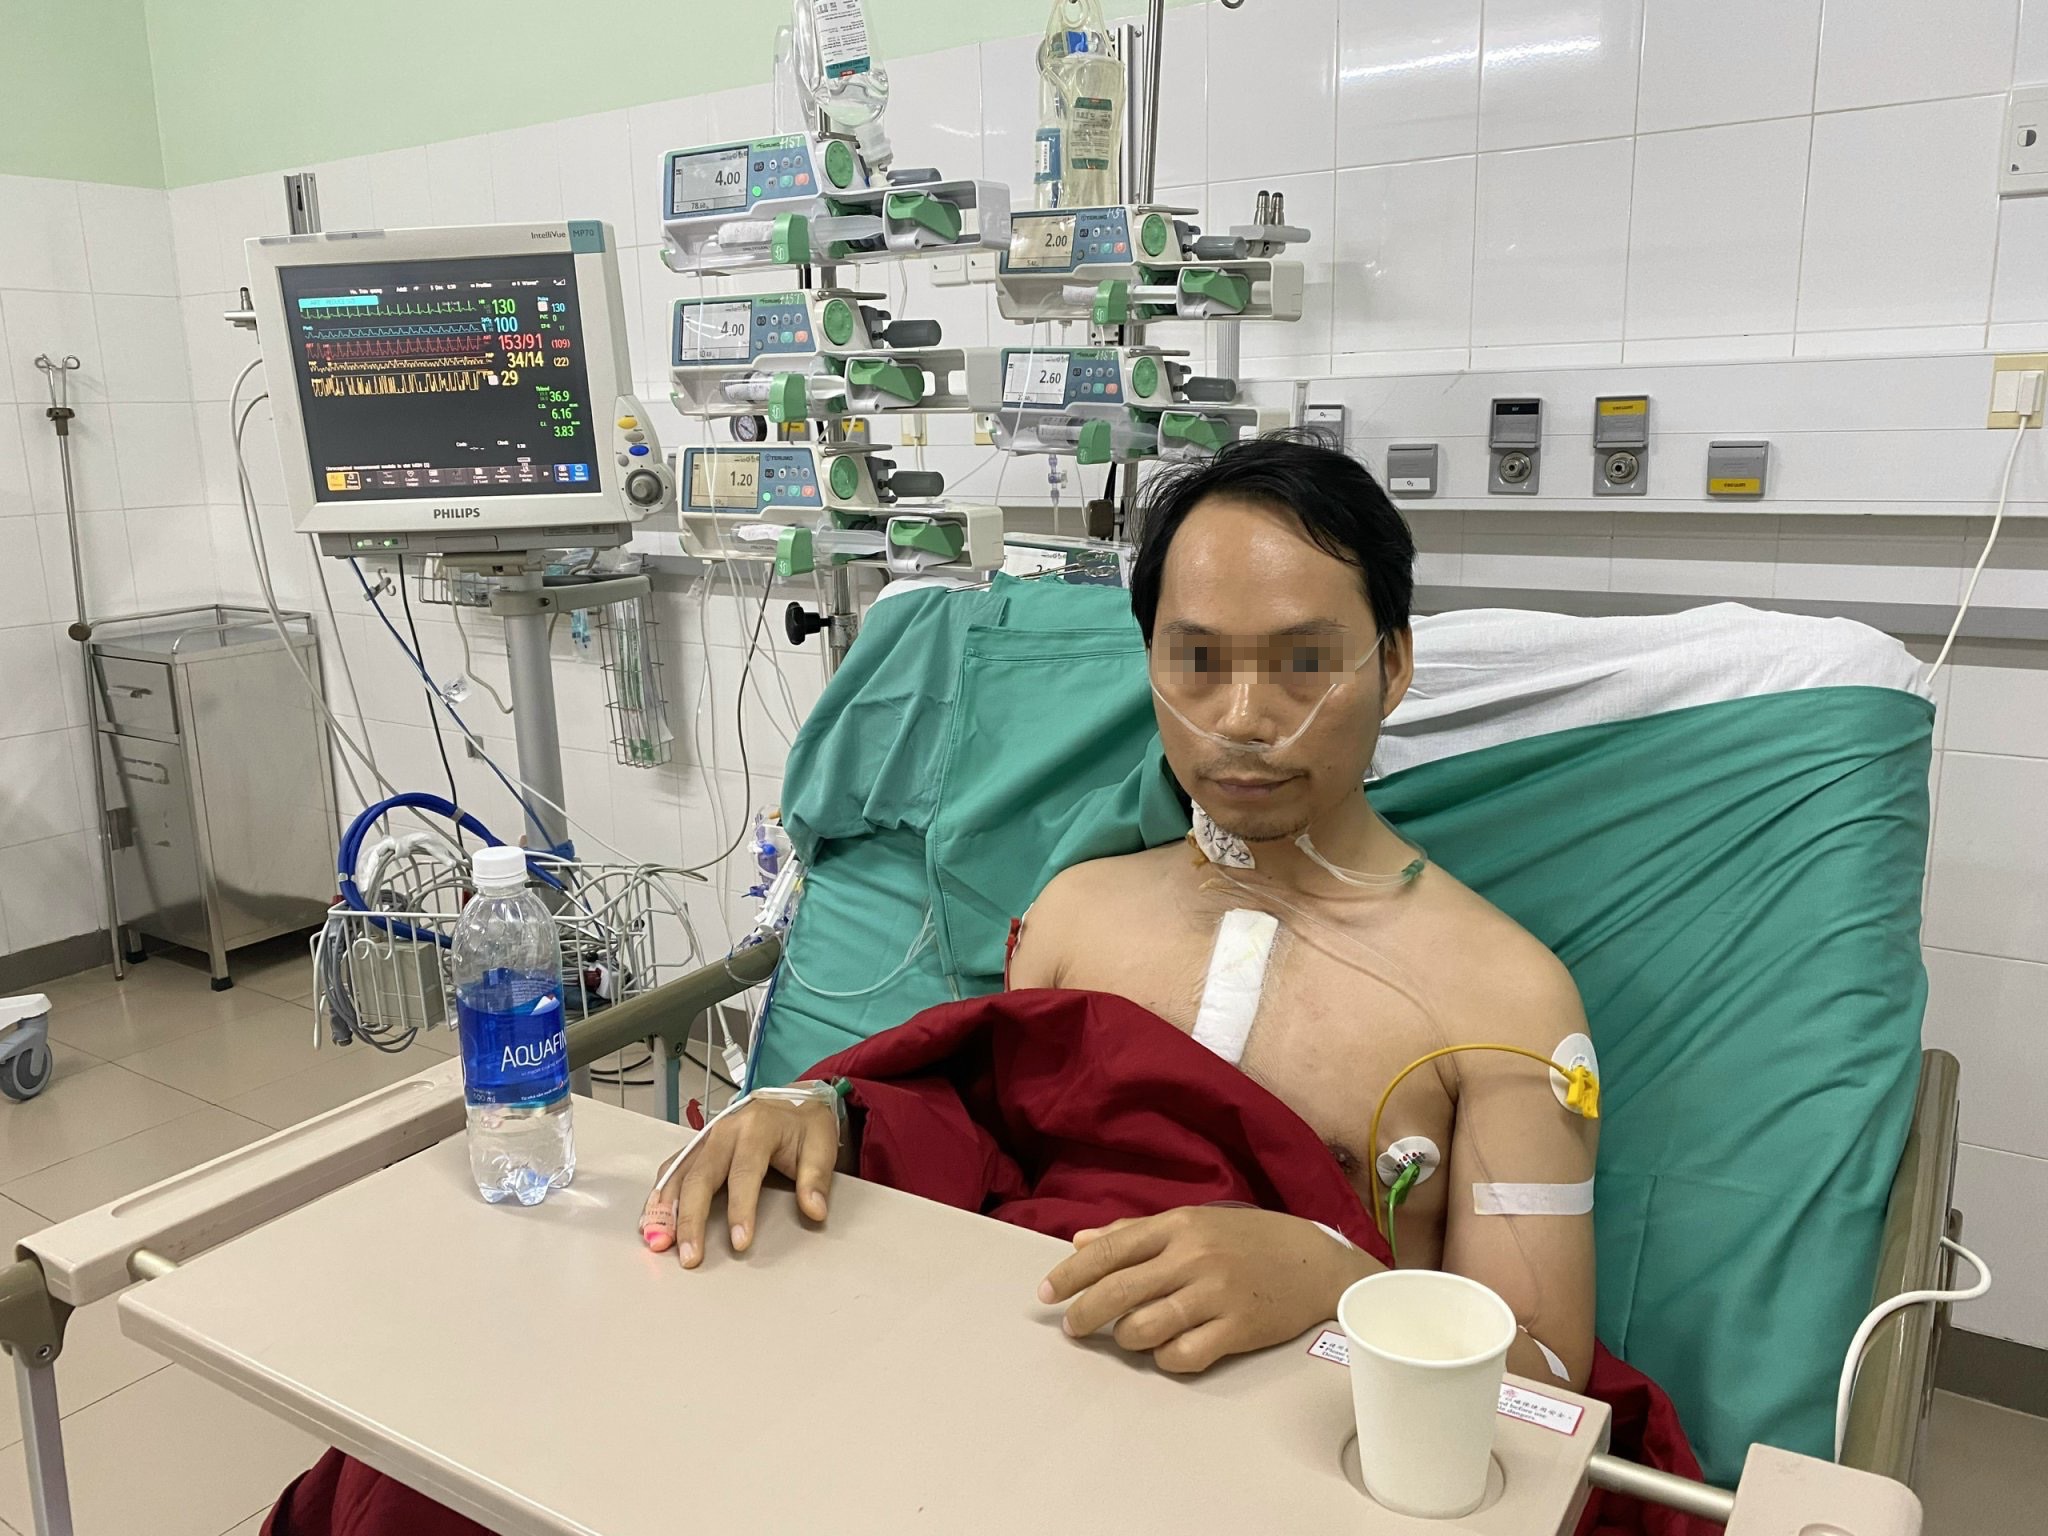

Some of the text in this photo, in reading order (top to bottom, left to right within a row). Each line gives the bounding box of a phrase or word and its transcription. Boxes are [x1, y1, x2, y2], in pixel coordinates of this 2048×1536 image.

[715, 170, 741, 186] 4.00
[531, 229, 594, 239] IntelliVue MP70
[1045, 233, 1068, 247] 2.00
[492, 299, 516, 314] 130
[551, 303, 566, 312] 130
[494, 316, 518, 332] 100
[720, 321, 745, 336] 4.00
[498, 333, 543, 350] 153/91
[551, 339, 571, 348] (109)
[506, 351, 544, 367] 34/14
[553, 357, 569, 367] (22)
[500, 370, 519, 386] 29
[1039, 370, 1061, 384] 2.60
[549, 390, 570, 402] 36.9
[551, 407, 572, 420] 6.16
[553, 425, 574, 437] 3.83
[730, 470, 753, 486] 1.20
[433, 507, 480, 519] PHILIPS
